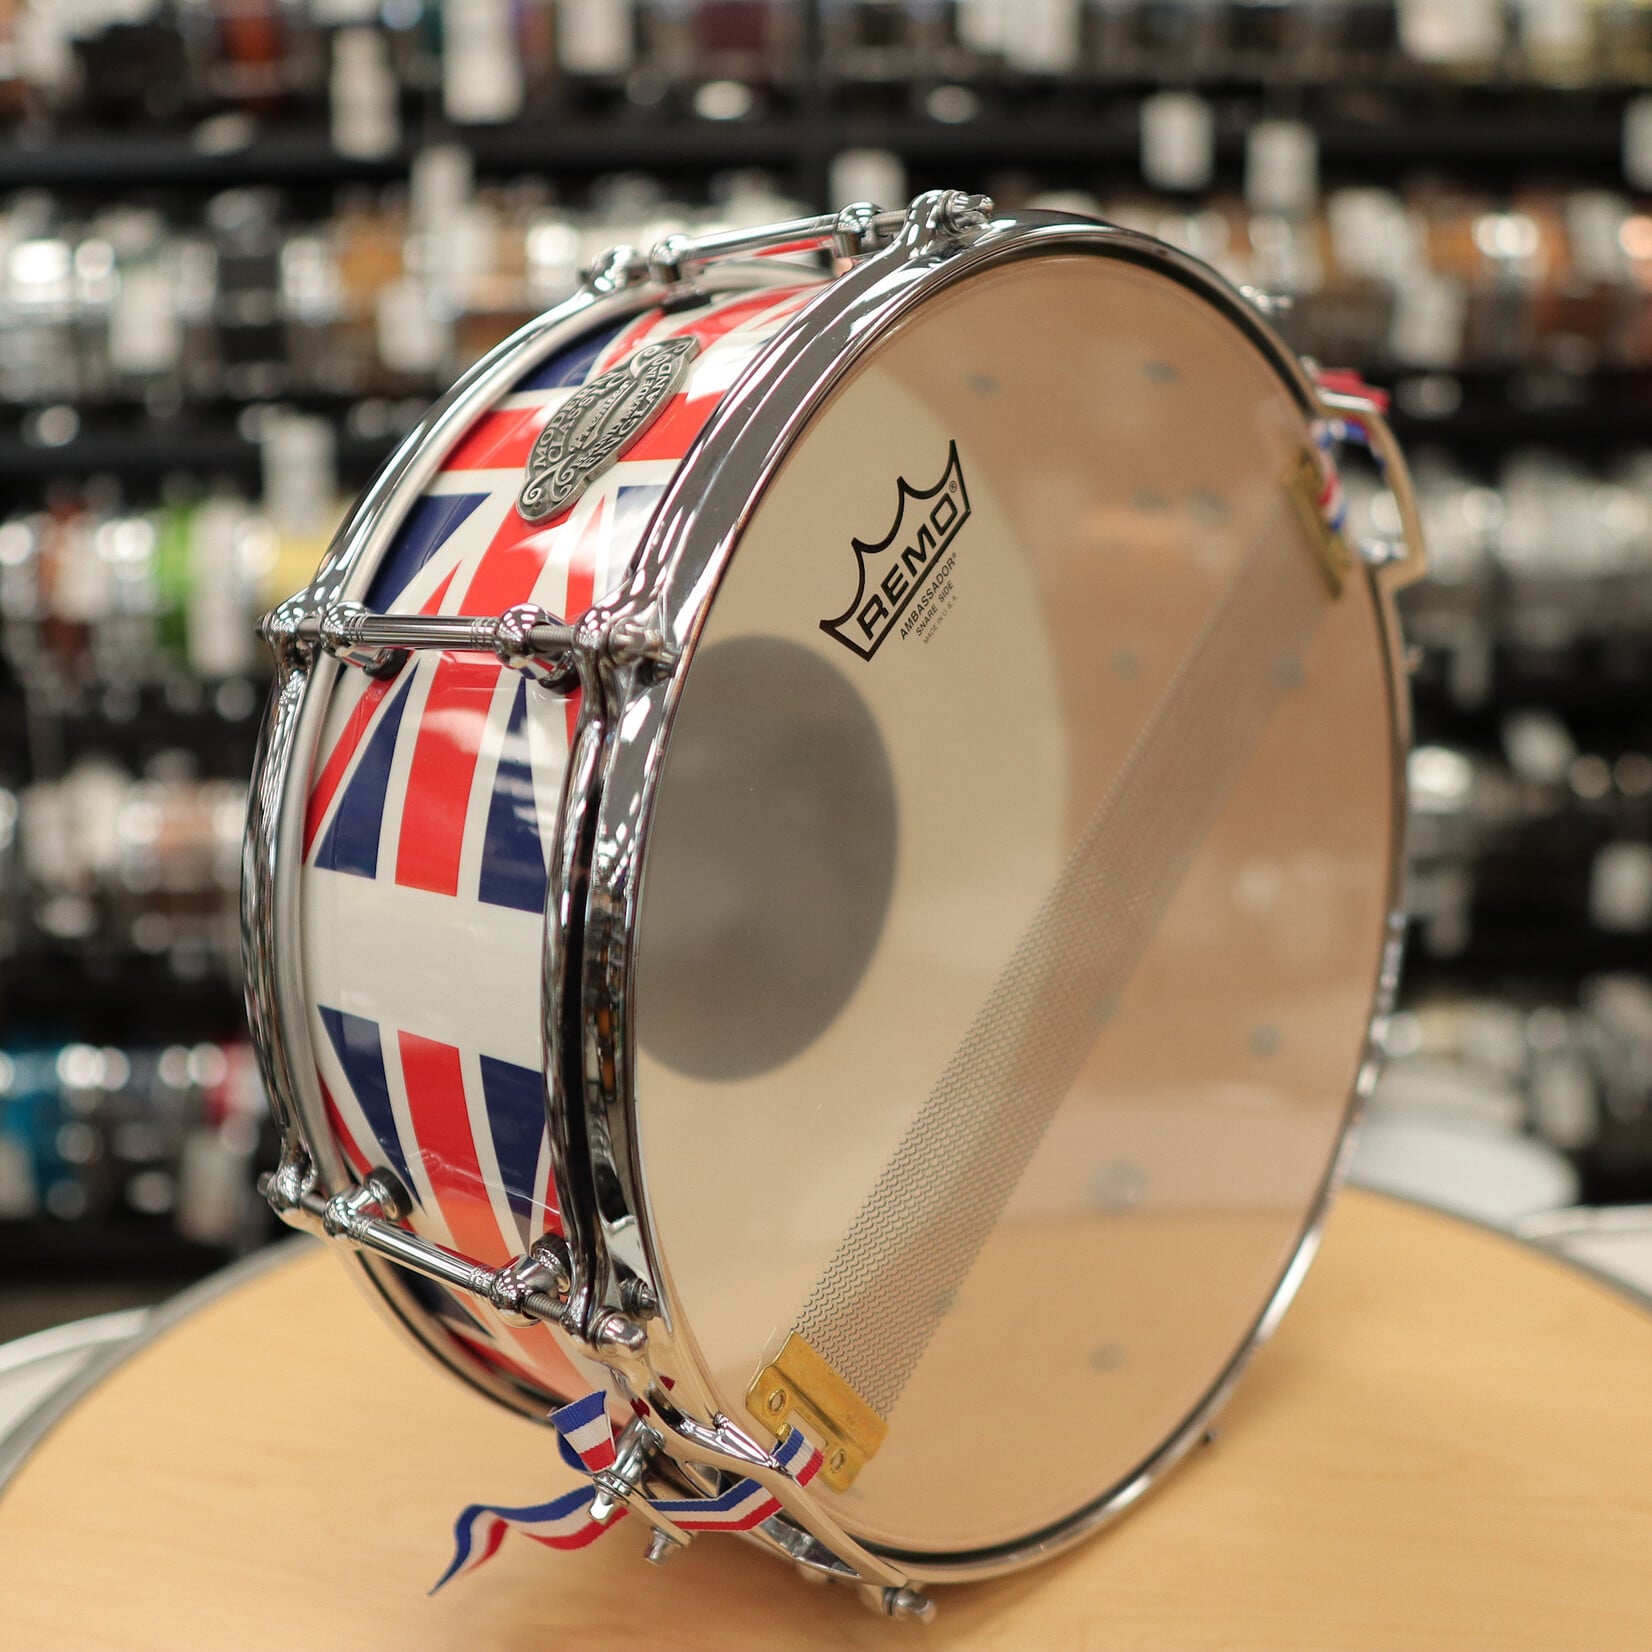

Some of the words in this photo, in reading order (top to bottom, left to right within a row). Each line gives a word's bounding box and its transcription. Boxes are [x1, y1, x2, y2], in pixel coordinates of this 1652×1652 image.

[533, 370, 622, 469] MODERN
[547, 374, 629, 463] CLASSIC
[568, 380, 631, 453] Premier
[572, 422, 622, 467] HAND
[625, 379, 654, 420] MADE
[646, 365, 659, 379] IN
[578, 362, 672, 468] ENGLAND
[856, 492, 958, 641] REMO
[900, 557, 956, 640] AMBASSADOR
[916, 603, 938, 636] SNARE
[938, 580, 954, 603] SIDE
